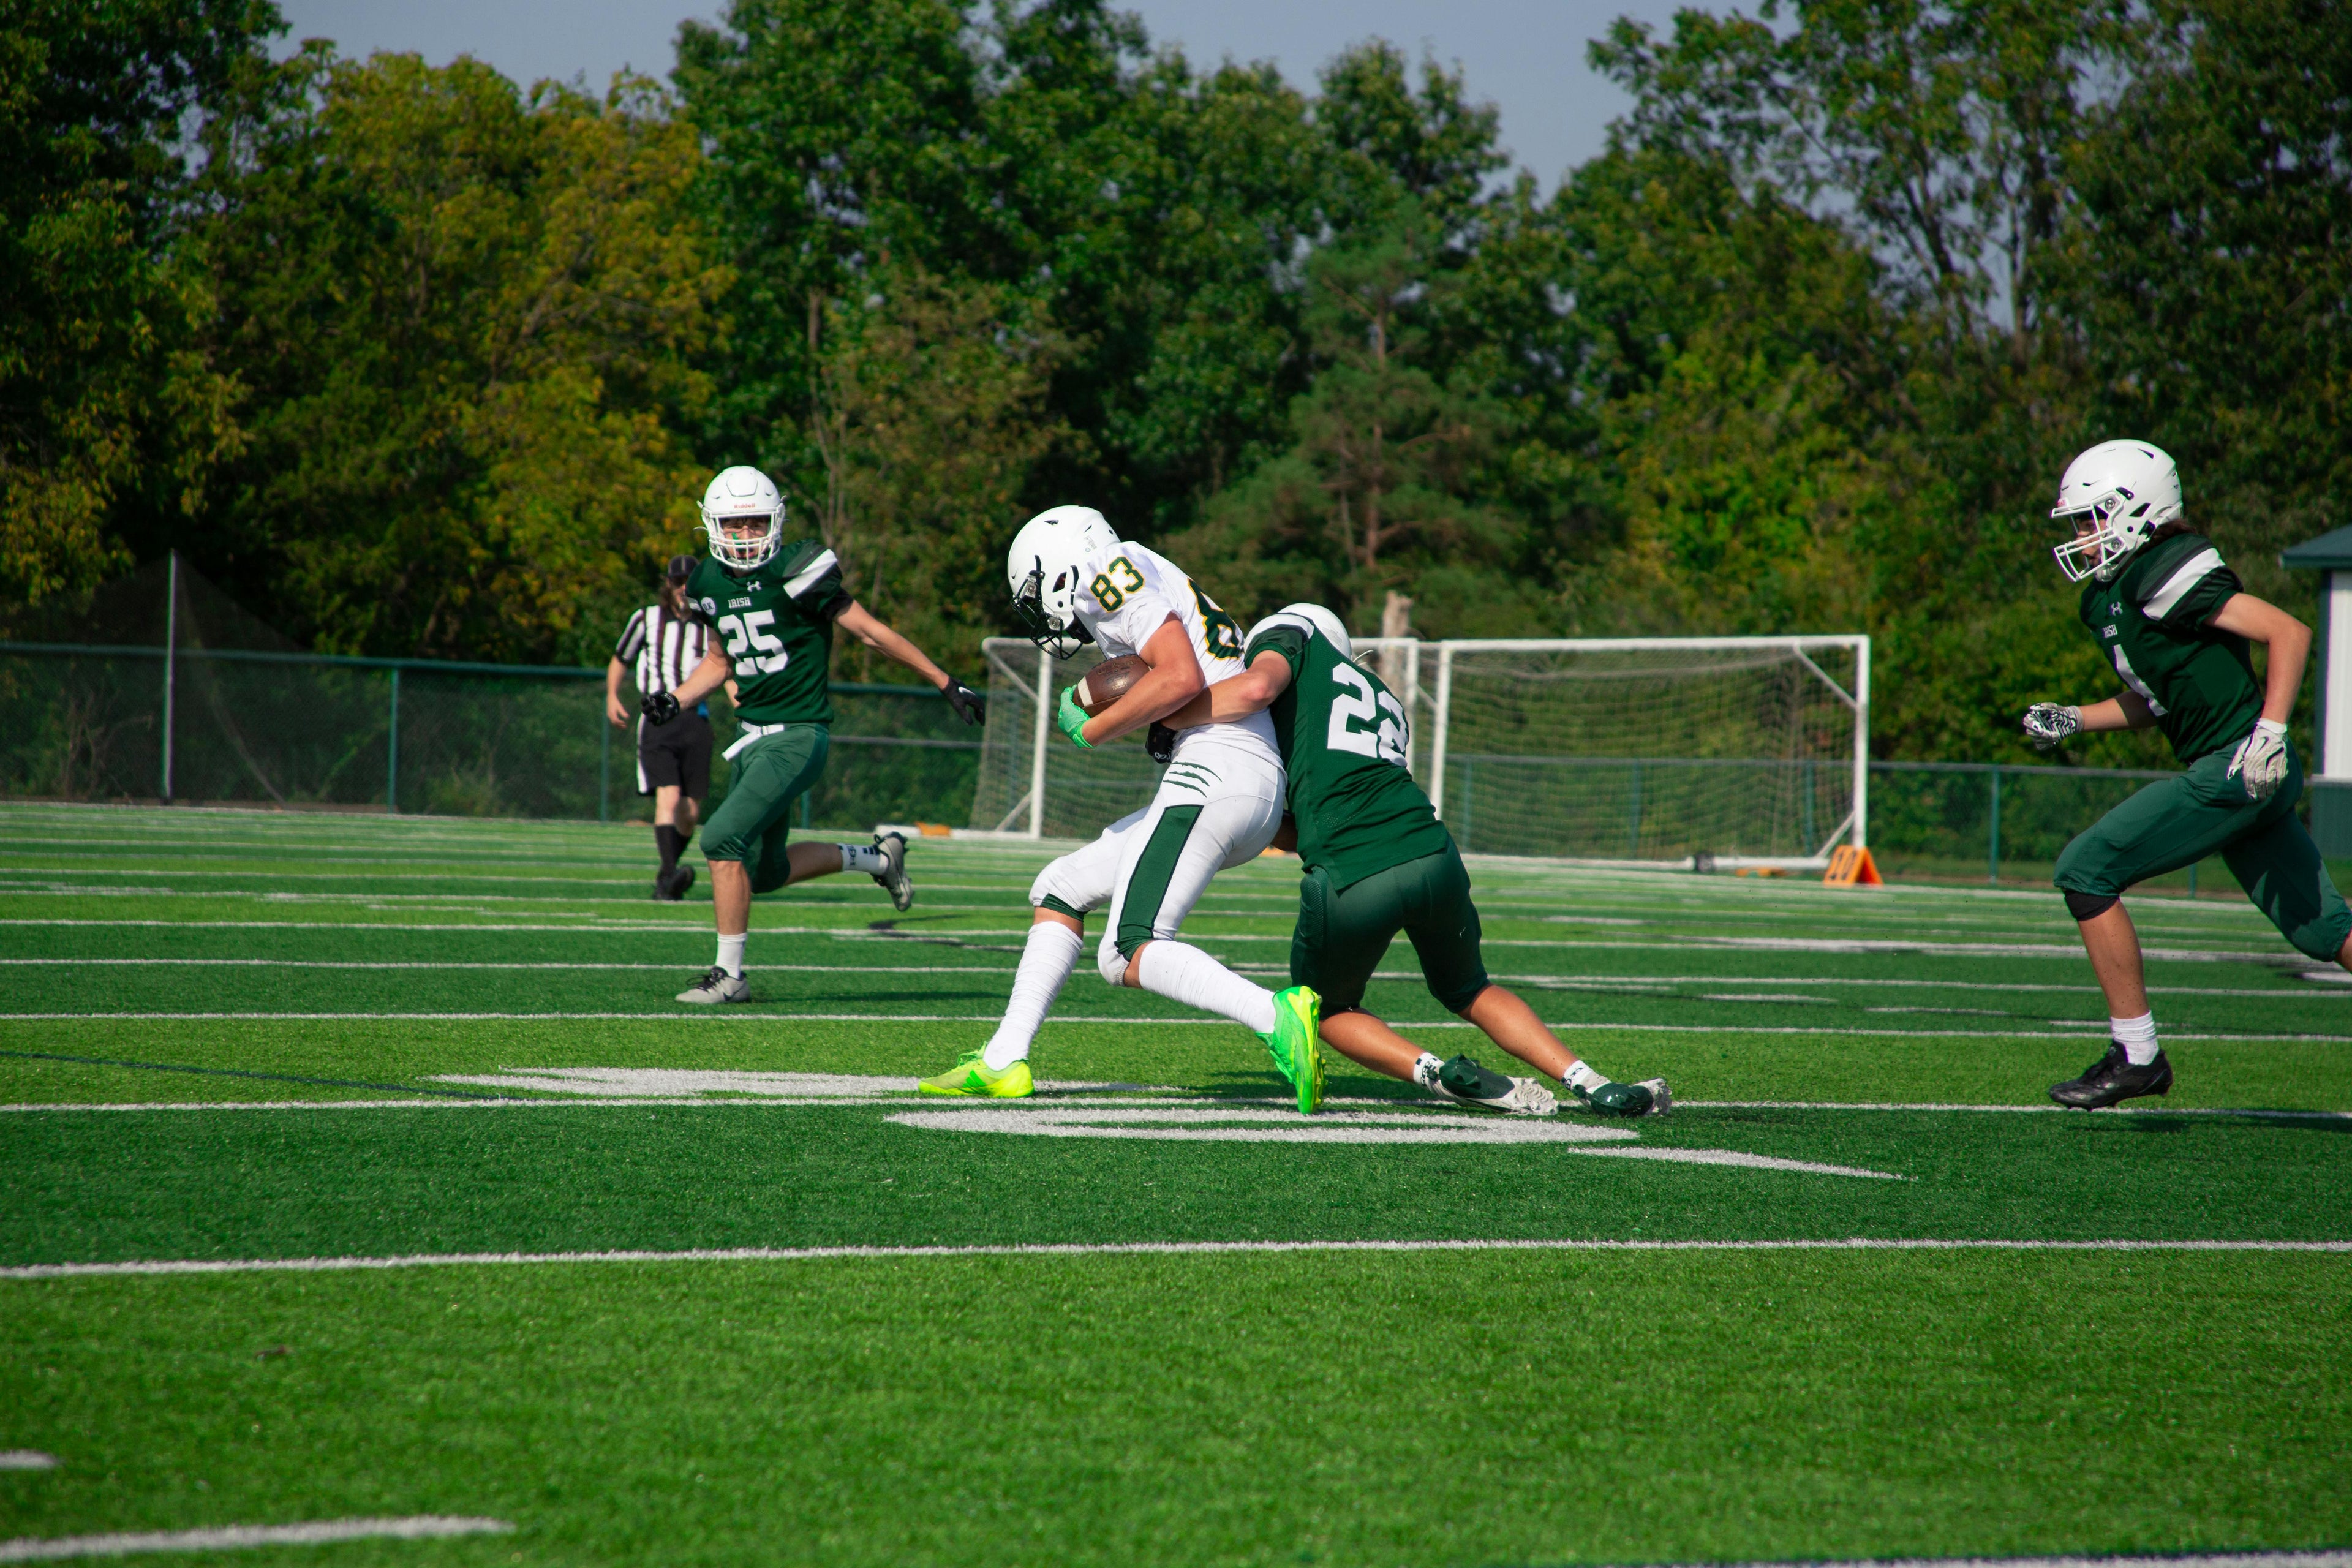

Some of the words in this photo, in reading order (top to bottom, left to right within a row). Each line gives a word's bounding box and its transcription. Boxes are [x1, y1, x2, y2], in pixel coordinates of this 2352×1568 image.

[728, 597, 752, 609] IRISH
[1089, 556, 1145, 612] 83
[718, 609, 788, 676] 25
[2103, 624, 2118, 638] IRISH
[1327, 662, 1408, 767] 22
